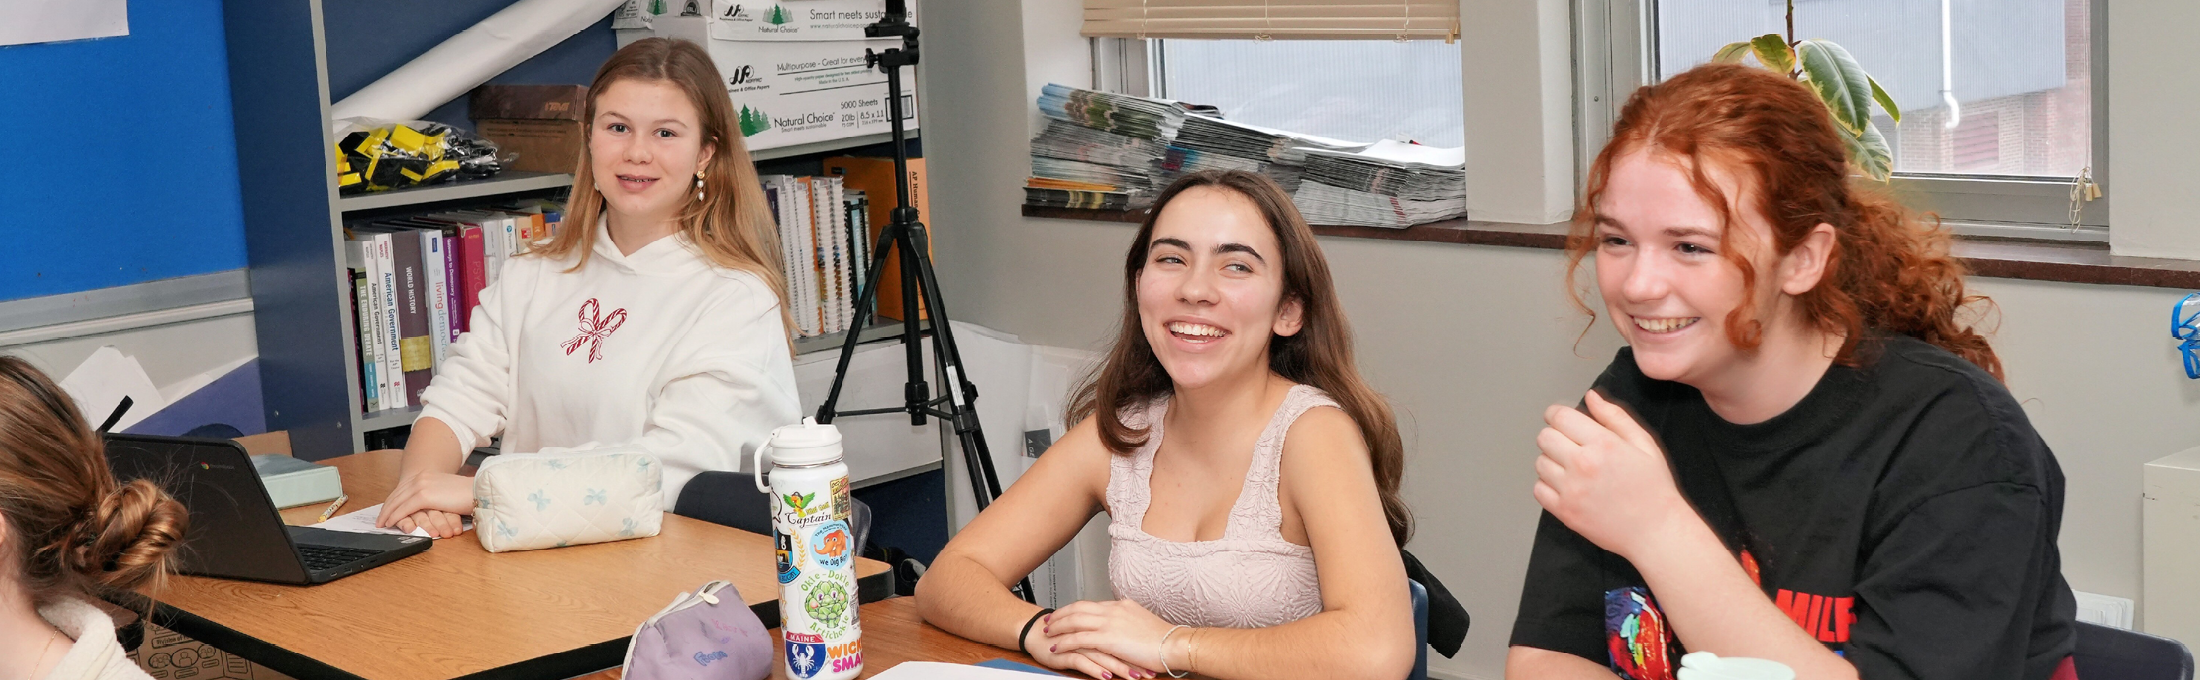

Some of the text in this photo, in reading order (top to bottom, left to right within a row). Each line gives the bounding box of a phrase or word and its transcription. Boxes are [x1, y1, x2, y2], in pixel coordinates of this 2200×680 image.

[810, 9, 835, 20] Smart
[838, 10, 862, 20] meets
[777, 60, 816, 72] Multipurpose
[849, 56, 867, 66] every
[841, 99, 878, 109] 5000 Sheets
[774, 112, 833, 128] Natural Choice
[842, 113, 855, 122] 20lb
[860, 111, 870, 119] 8.5
[876, 110, 884, 118] 11
[912, 171, 918, 181] AP
[406, 266, 414, 288] WORLD
[361, 299, 369, 331] ENDURING
[385, 273, 398, 351] American Government
[374, 311, 382, 344] Government
[364, 334, 372, 356] DEBATE
[785, 512, 831, 528] Captain
[830, 557, 839, 566] Dig
[810, 615, 849, 639] Artichokie
[790, 634, 816, 642] MAINE
[827, 638, 862, 659] WICK
[832, 653, 863, 673] SMA
